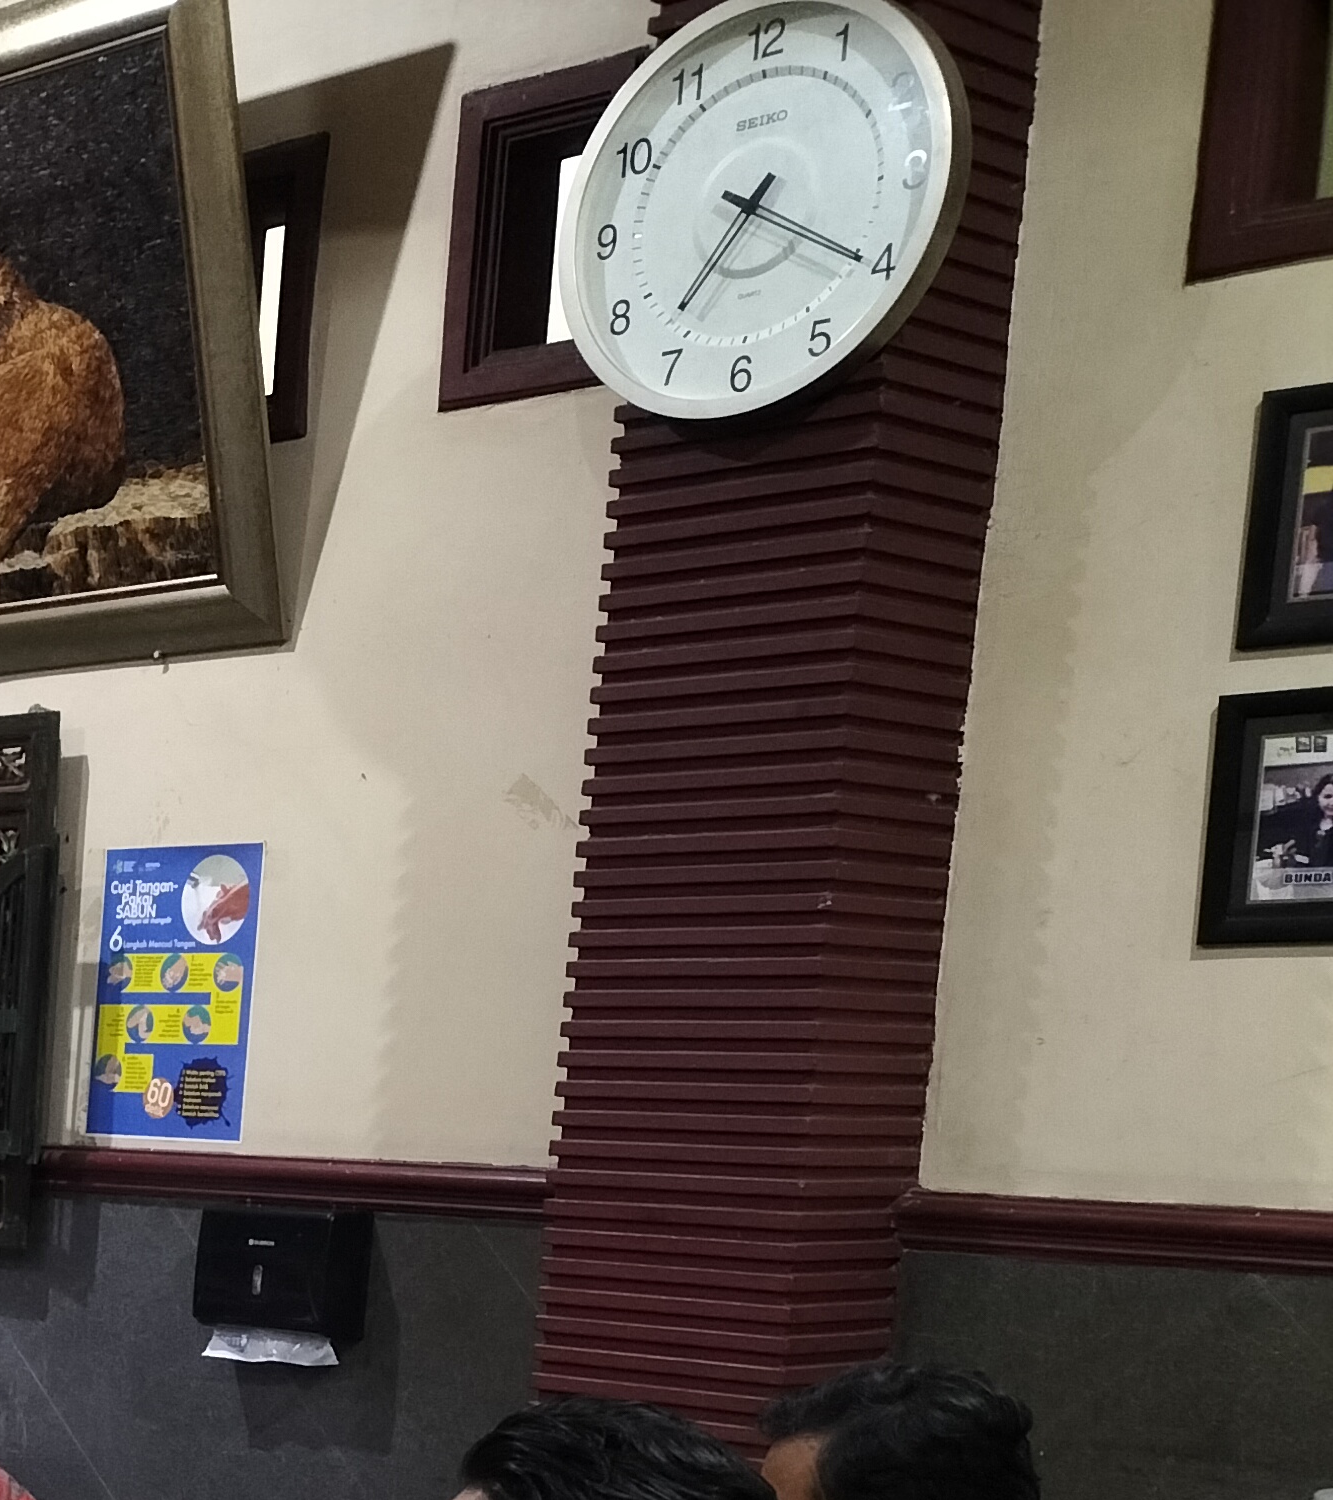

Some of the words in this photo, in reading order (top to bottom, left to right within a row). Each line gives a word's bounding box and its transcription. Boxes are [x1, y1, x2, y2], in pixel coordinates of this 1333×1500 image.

[748, 17, 786, 61] 12
[835, 23, 850, 62] 1
[672, 63, 705, 106] 11
[735, 109, 788, 132] SEIKO
[616, 137, 653, 179] 10
[596, 224, 618, 261] 9
[870, 242, 896, 282] 4
[609, 299, 631, 336] 8
[807, 317, 832, 357] 5
[661, 348, 684, 387] 7
[729, 355, 753, 393] 6
[1284, 872, 1332, 884] BUNDA
[115, 903, 157, 919] SABUN
[109, 925, 123, 952] 6
[146, 1080, 173, 1108] 60
